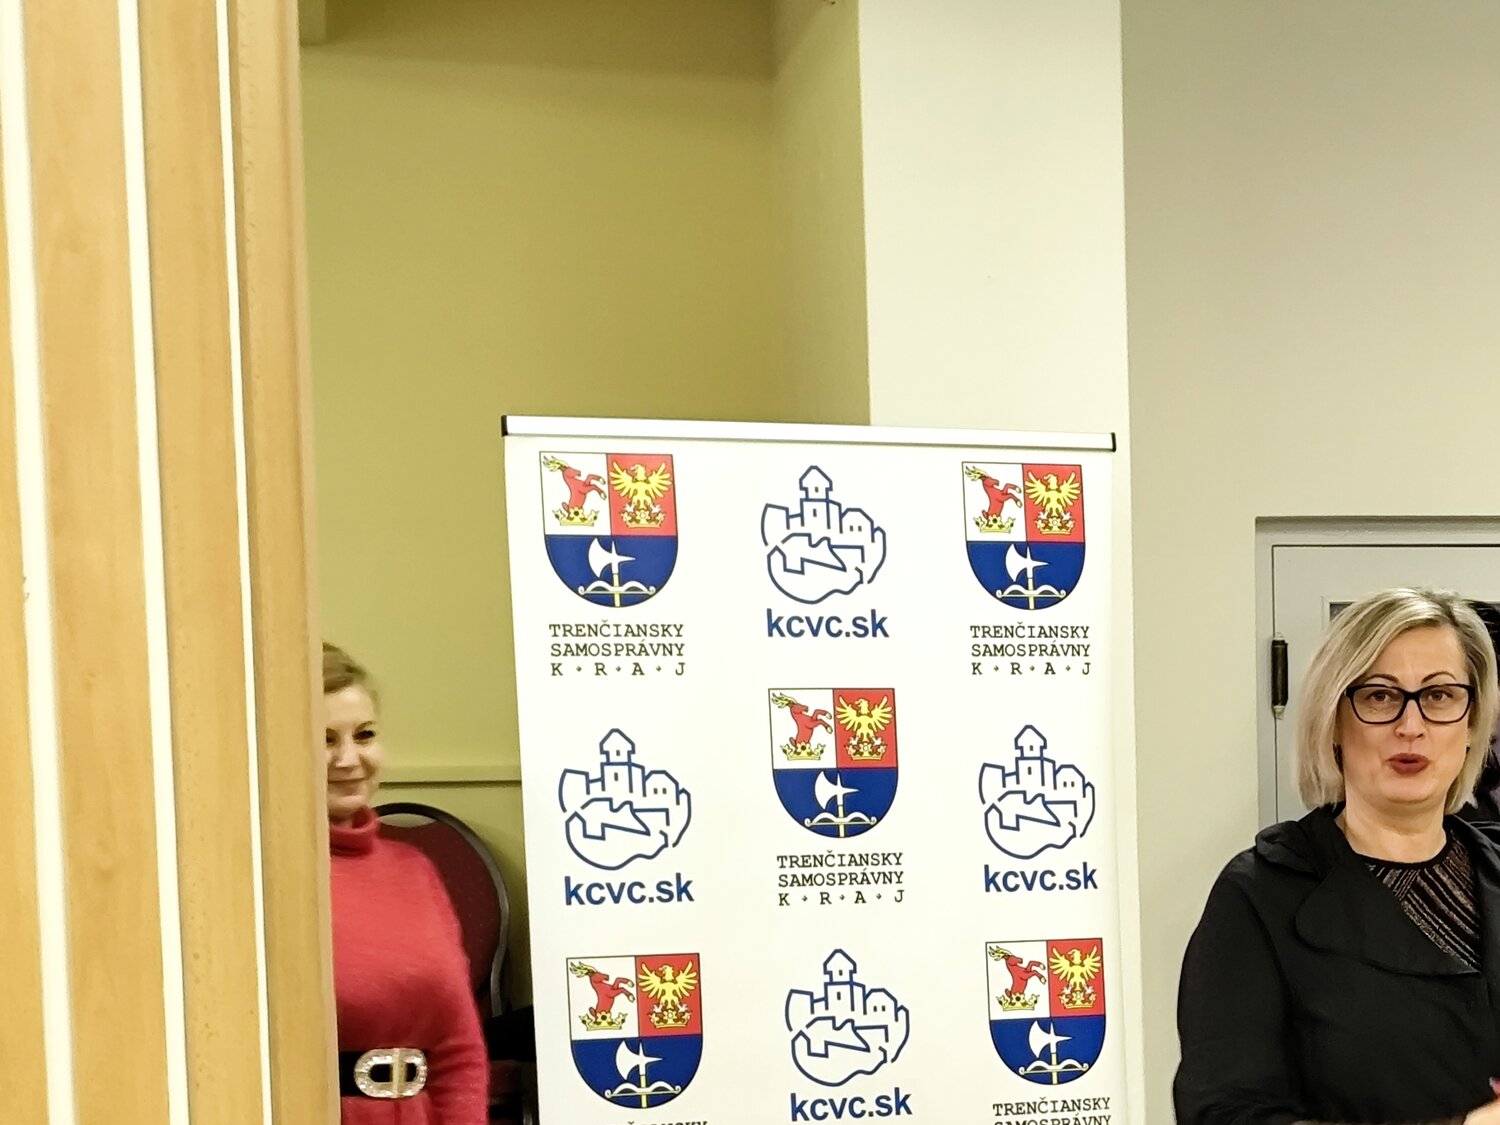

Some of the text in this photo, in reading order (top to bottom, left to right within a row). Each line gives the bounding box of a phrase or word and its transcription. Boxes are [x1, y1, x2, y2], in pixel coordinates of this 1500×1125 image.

[548, 619, 684, 637] TRENČIANSKY
[766, 609, 889, 637] kcvc.sk
[969, 621, 1090, 639] TRENČIANSKY
[550, 639, 685, 657] SAMOSPRÁVNY
[971, 641, 1091, 657] SAMOSPRÁVNY
[777, 851, 902, 869] TRENČIANSKY
[779, 869, 903, 887] SAMOSPRÁVNY
[983, 862, 1097, 892] kcvc.sk
[564, 873, 694, 905] kcvc.sk
[790, 1087, 912, 1121] kcvc.sk
[993, 1098, 1110, 1116] TRENČIANSKY
